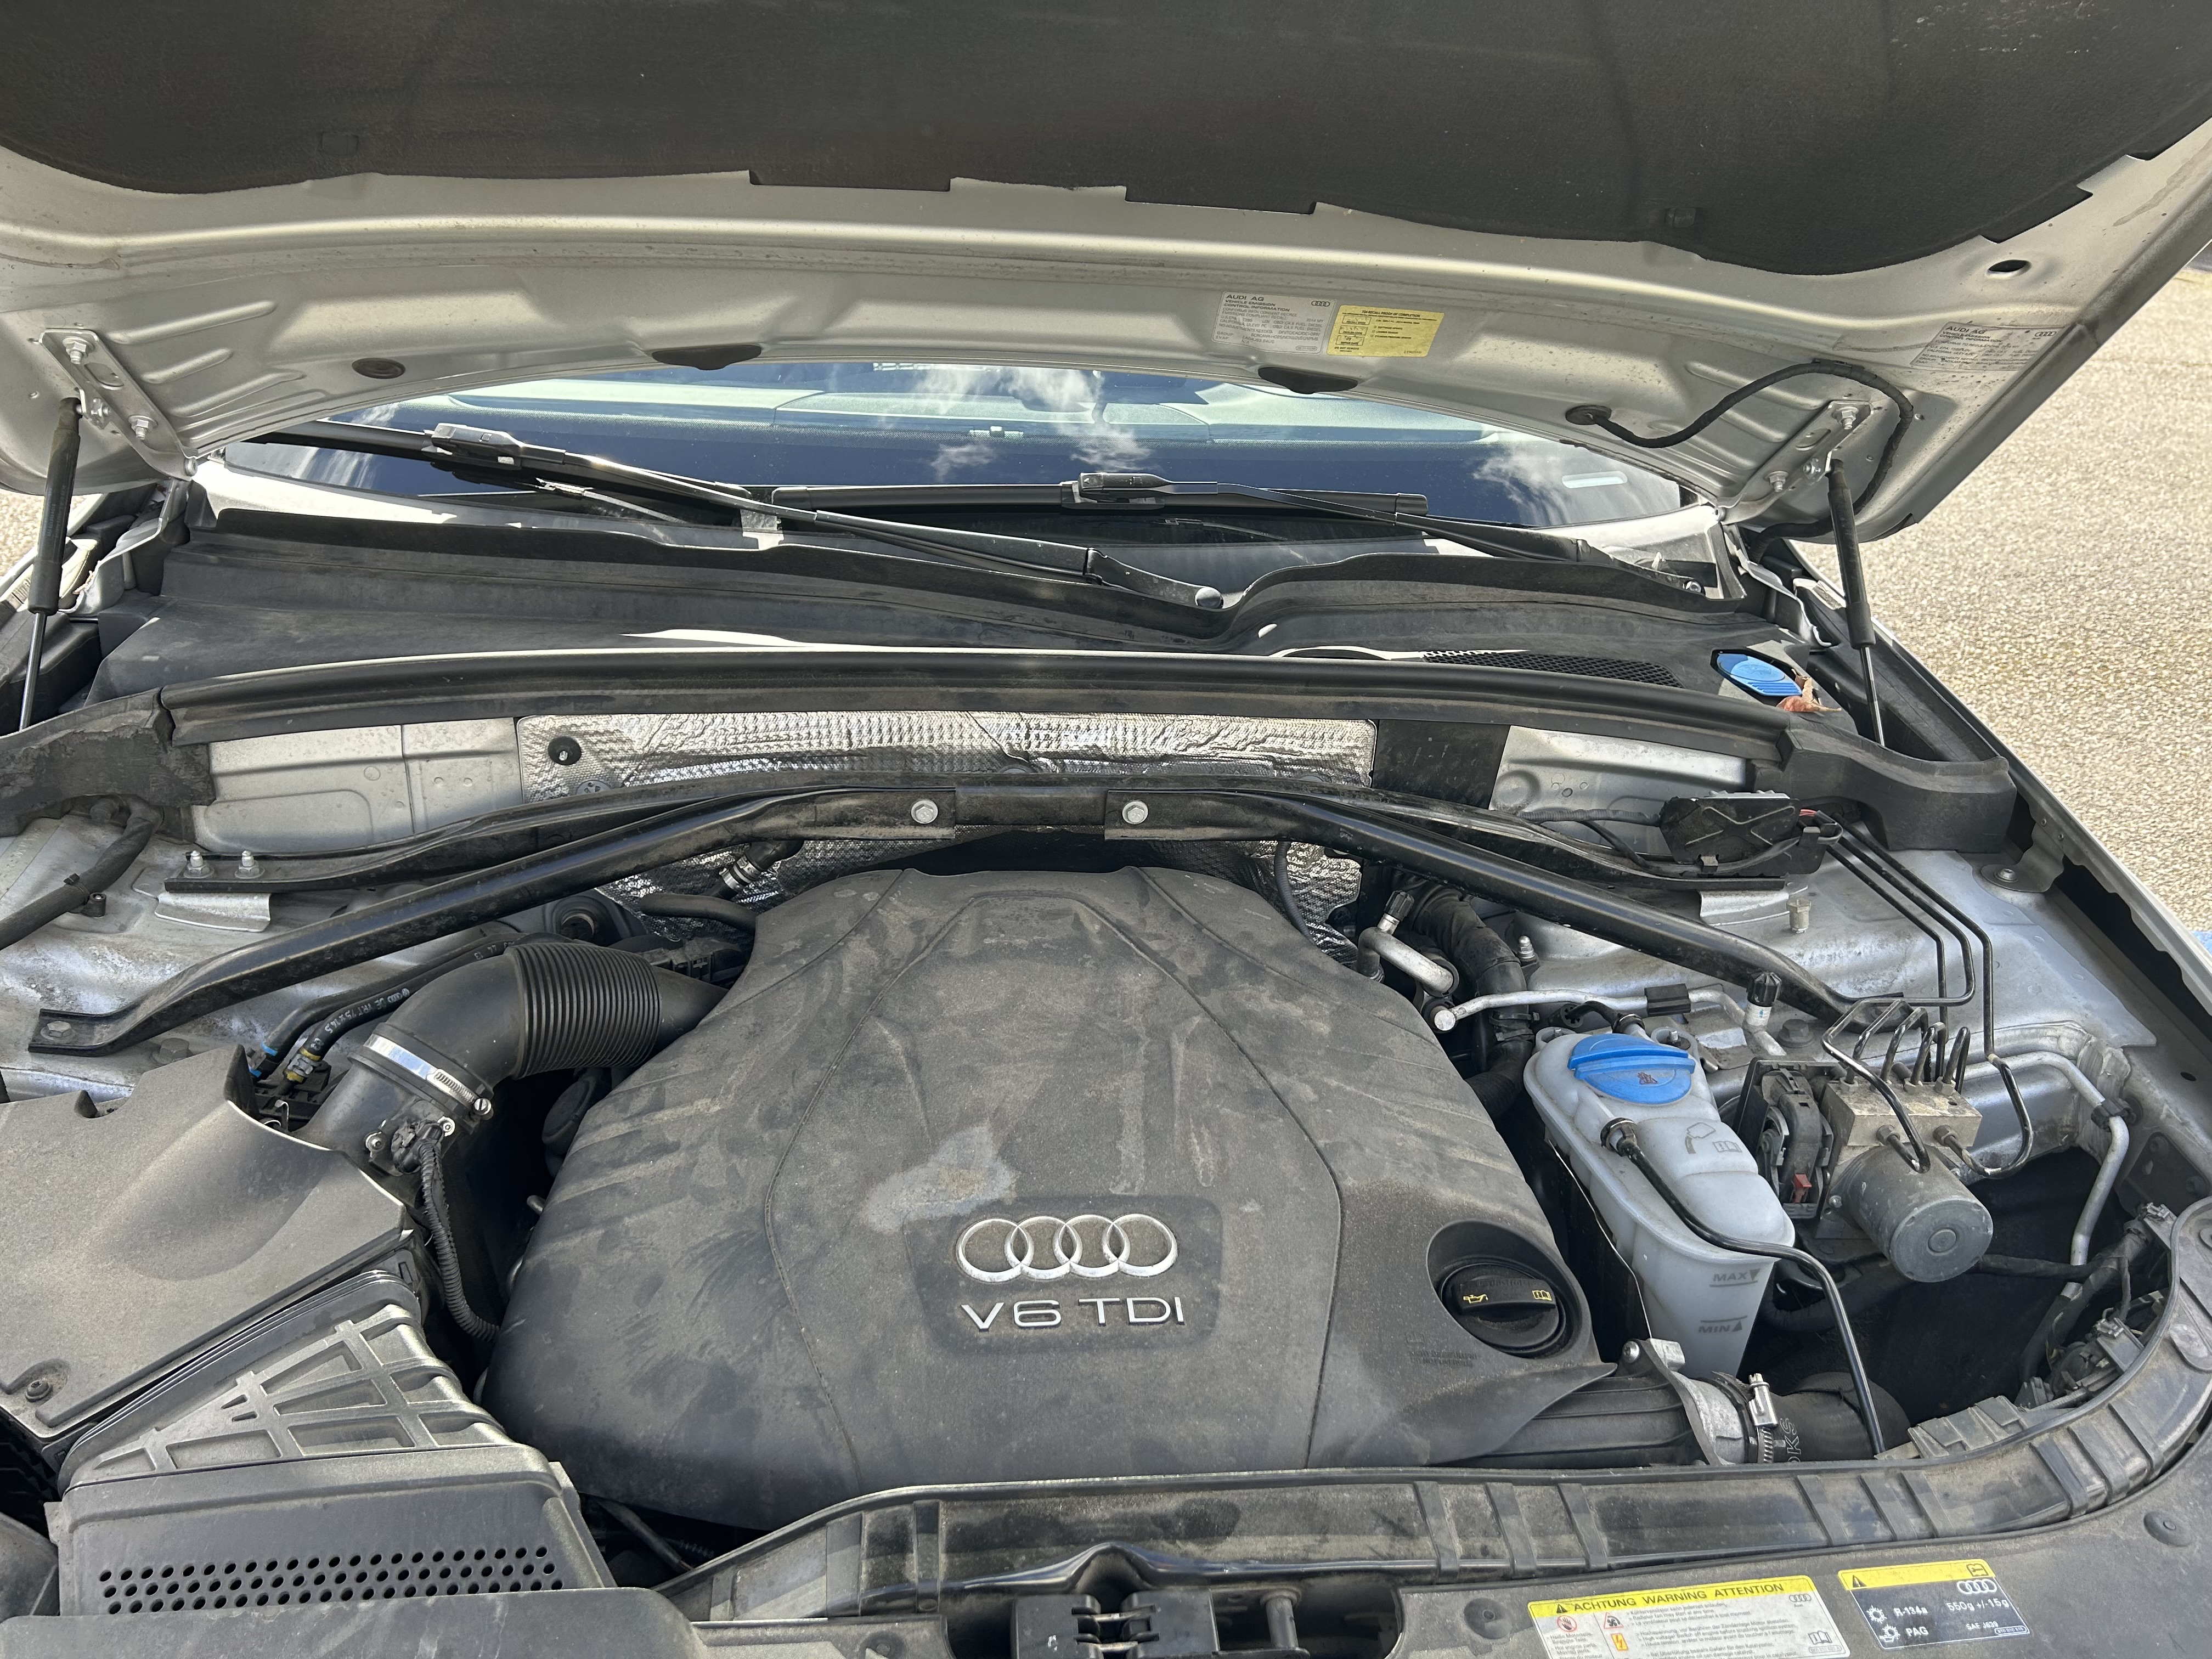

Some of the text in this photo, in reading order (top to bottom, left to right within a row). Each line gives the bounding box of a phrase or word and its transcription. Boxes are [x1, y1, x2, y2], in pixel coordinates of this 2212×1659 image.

[1713, 1272, 1748, 1282] MAX
[961, 1295, 1185, 1331] V6 TDI
[1699, 1324, 1730, 1333] MIN
[1573, 1583, 1785, 1611] ACHTUNG WARNING ATTENTION
[1893, 1605, 1929, 1617] R-134a
[1945, 1601, 1975, 1612] 550g
[1905, 1626, 1929, 1638] PAG
[1965, 1622, 1982, 1631] SAE
